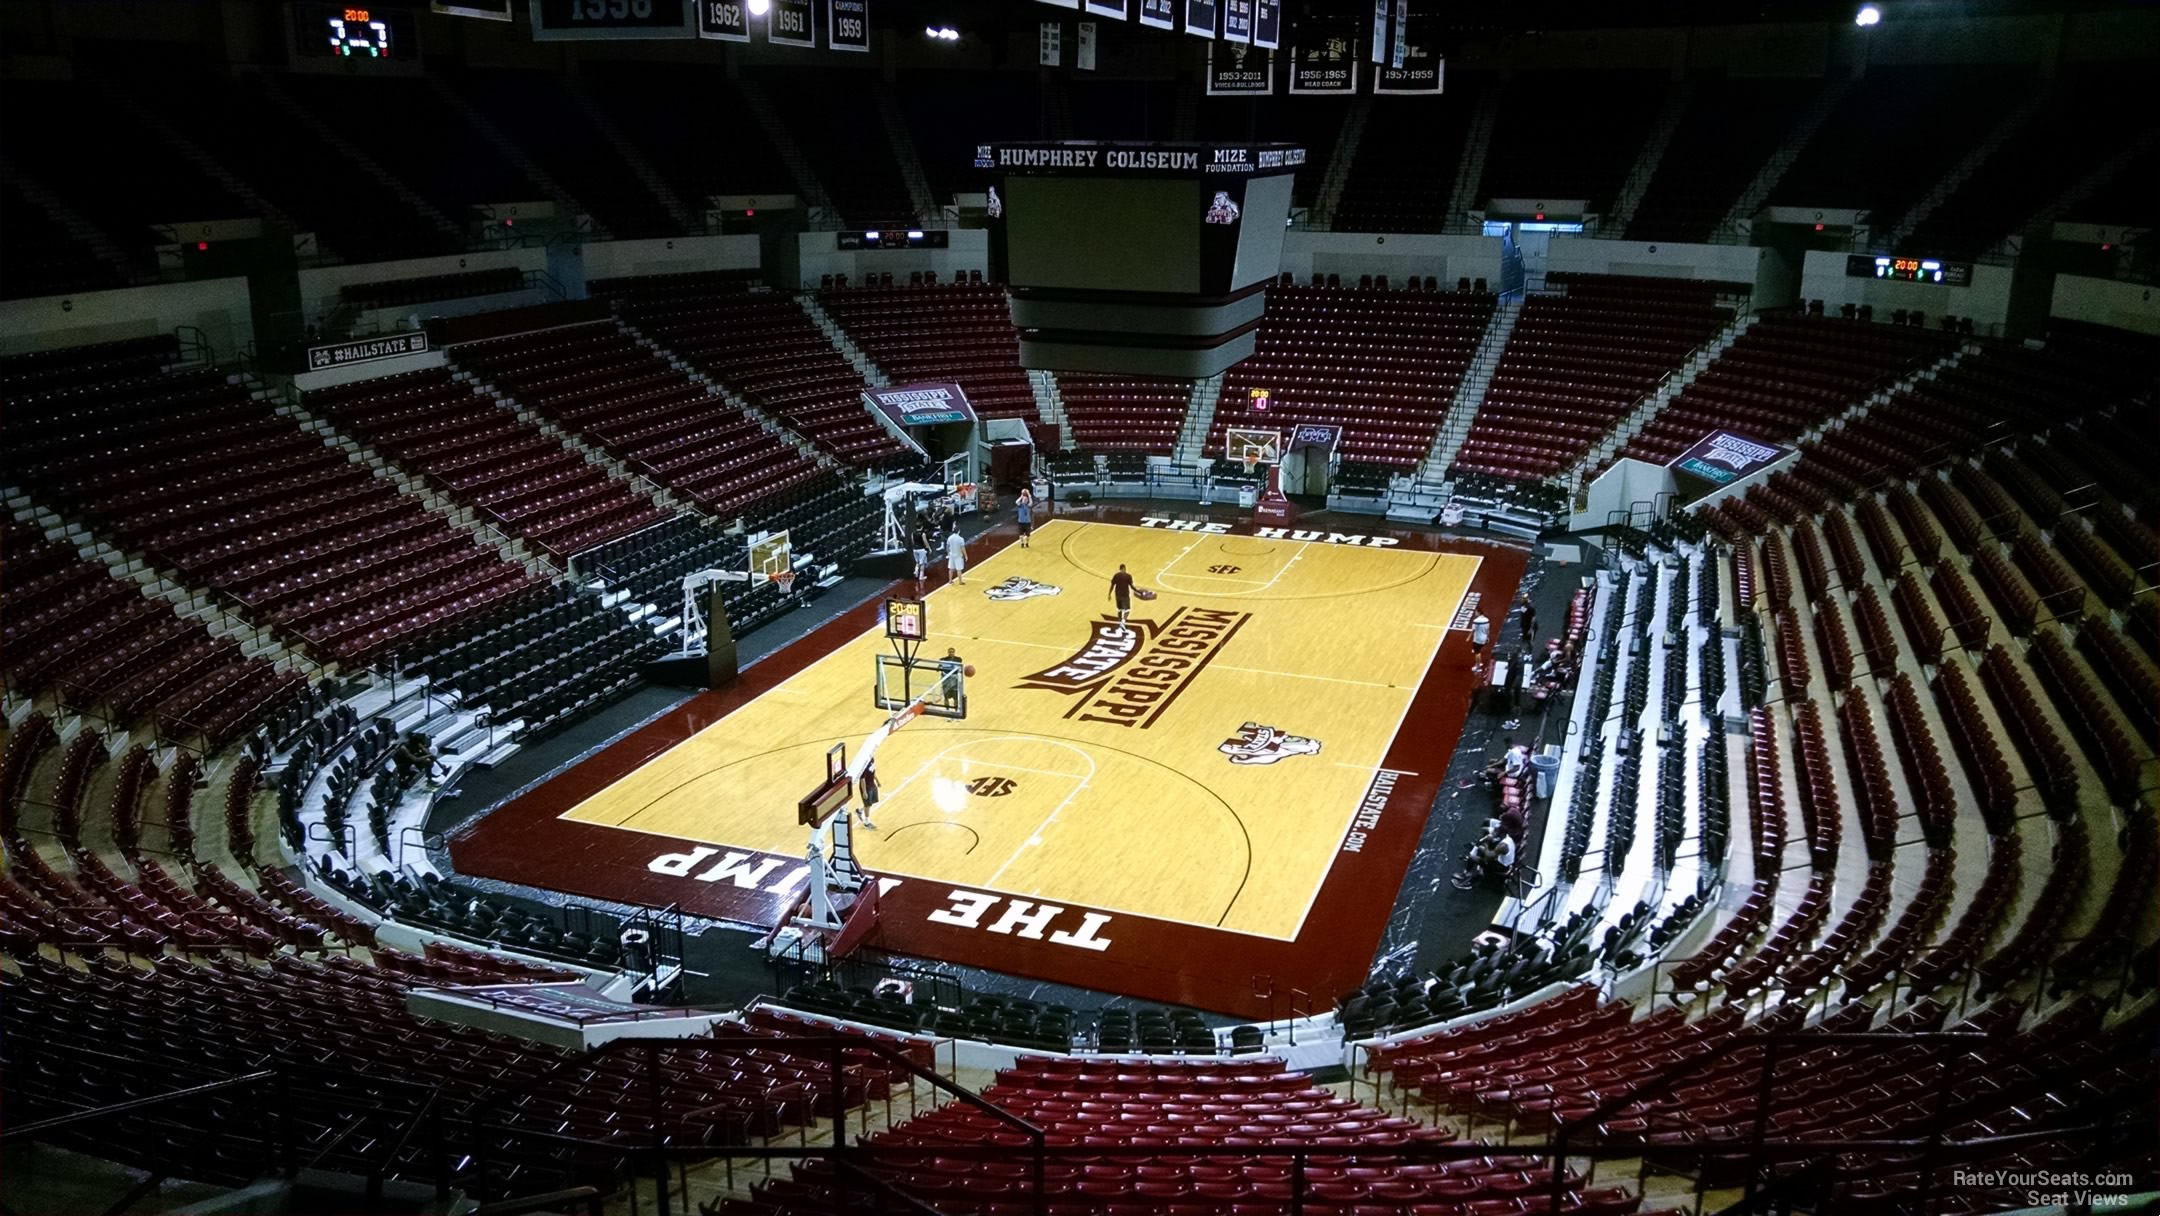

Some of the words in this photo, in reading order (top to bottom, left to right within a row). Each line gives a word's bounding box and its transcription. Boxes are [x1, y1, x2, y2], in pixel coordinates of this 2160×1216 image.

[710, 2, 740, 27] 1962
[778, 9, 805, 32] 1961
[837, 17, 863, 38] 1959
[1322, 80, 1342, 88] COACH
[1000, 149, 1098, 168] HUMPHREY
[1106, 151, 1199, 170] COLISEUM
[1213, 148, 1247, 163] MIZE
[1205, 163, 1255, 173] FOUNDATION
[334, 339, 406, 362] #HAILSTATE
[879, 388, 952, 404] MISSISSIPPI
[1710, 434, 1778, 462] MISSISSIPPI
[1140, 517, 1233, 535] THE
[1253, 527, 1400, 548] HUMP
[1207, 564, 1242, 574] SEC
[1043, 626, 1137, 681] STATE
[1078, 607, 1240, 728] MISSISSIPPI
[965, 776, 1018, 797] SEC
[1343, 771, 1400, 853] HAILSTATE.COM
[926, 889, 1113, 952] THE
